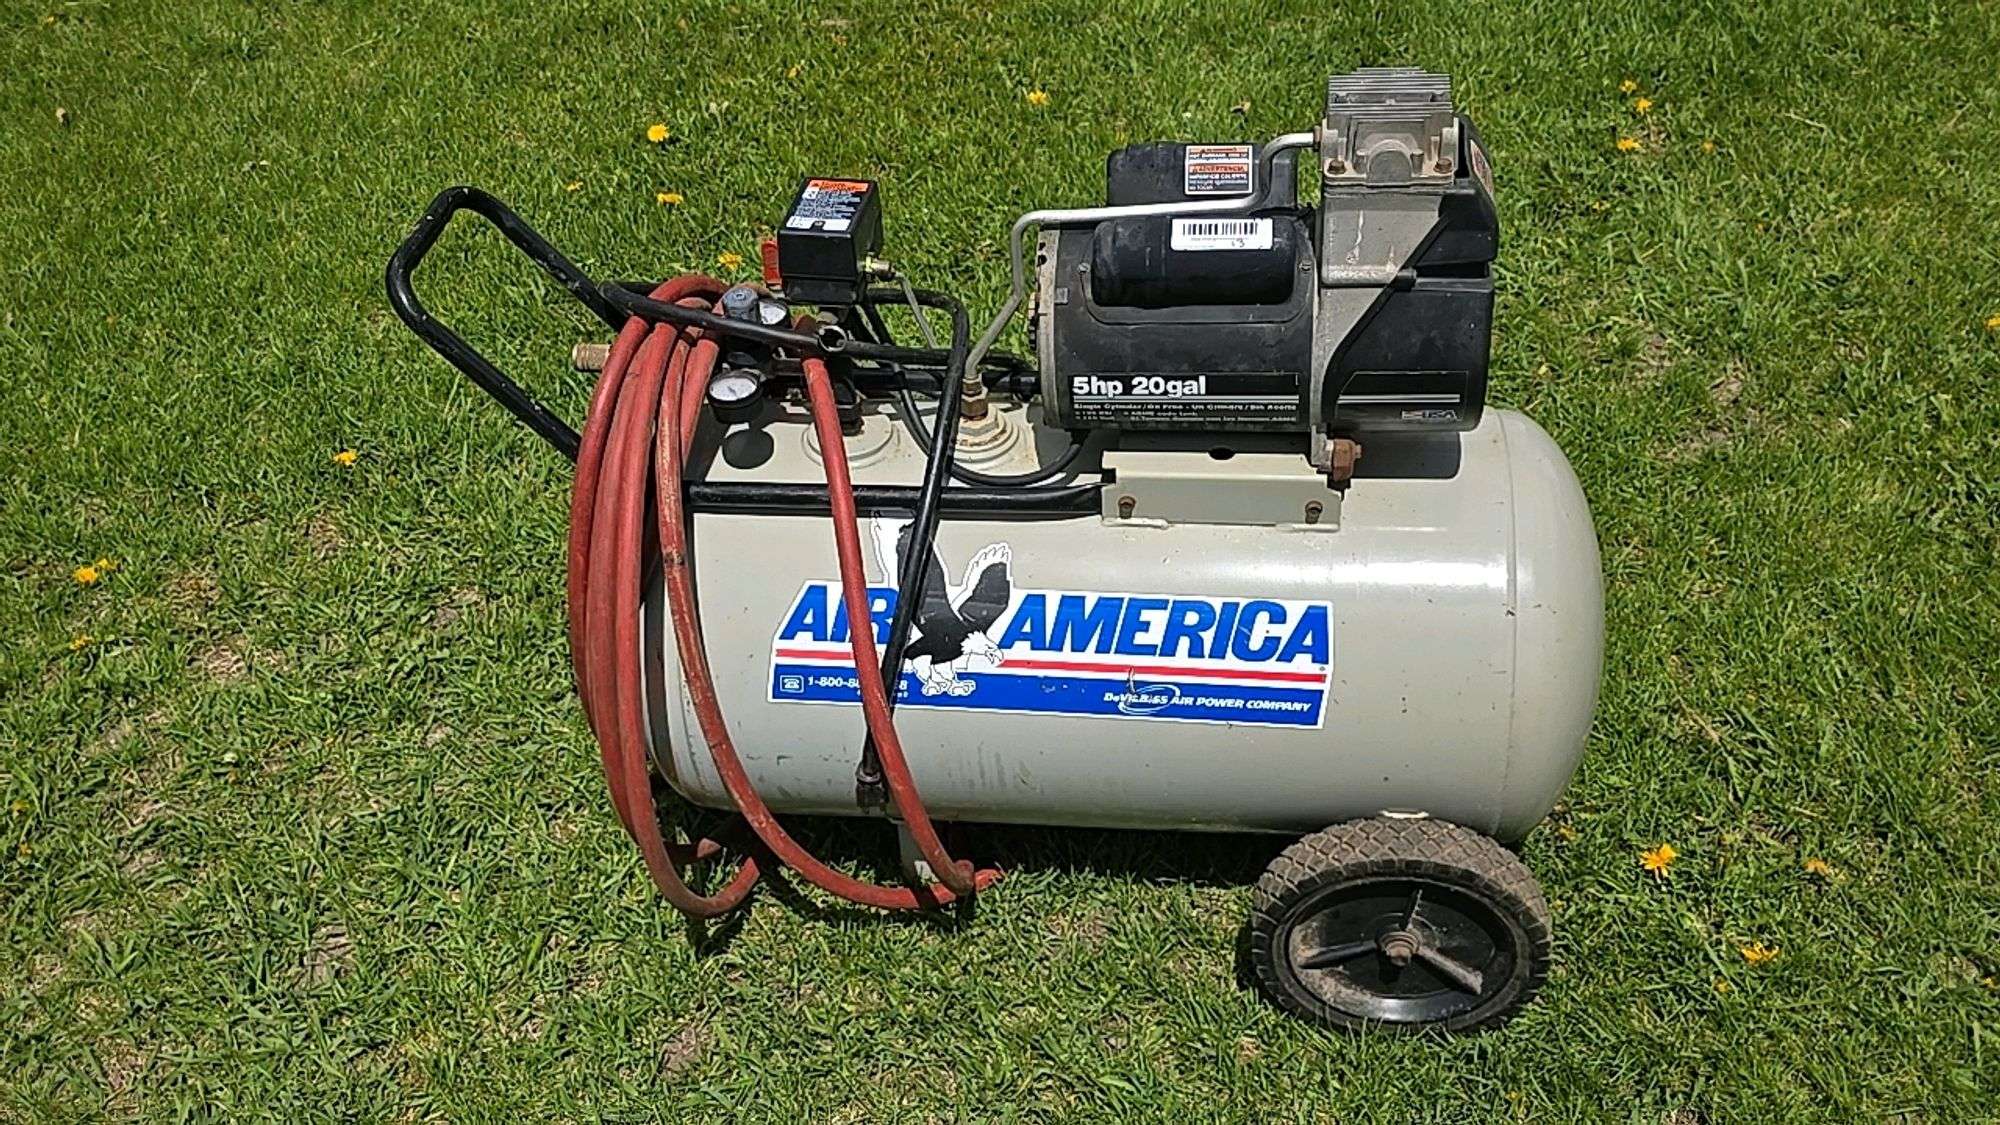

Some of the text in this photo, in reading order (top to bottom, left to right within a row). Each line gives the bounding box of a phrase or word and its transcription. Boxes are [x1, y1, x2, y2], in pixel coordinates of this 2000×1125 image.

[1072, 375, 1206, 398] 5hp 20gal
[779, 585, 1329, 665] AIR AMERICA
[1171, 695, 1194, 706] AIR
[1196, 697, 1245, 709] POWER
[1246, 700, 1311, 712] COMPANY
